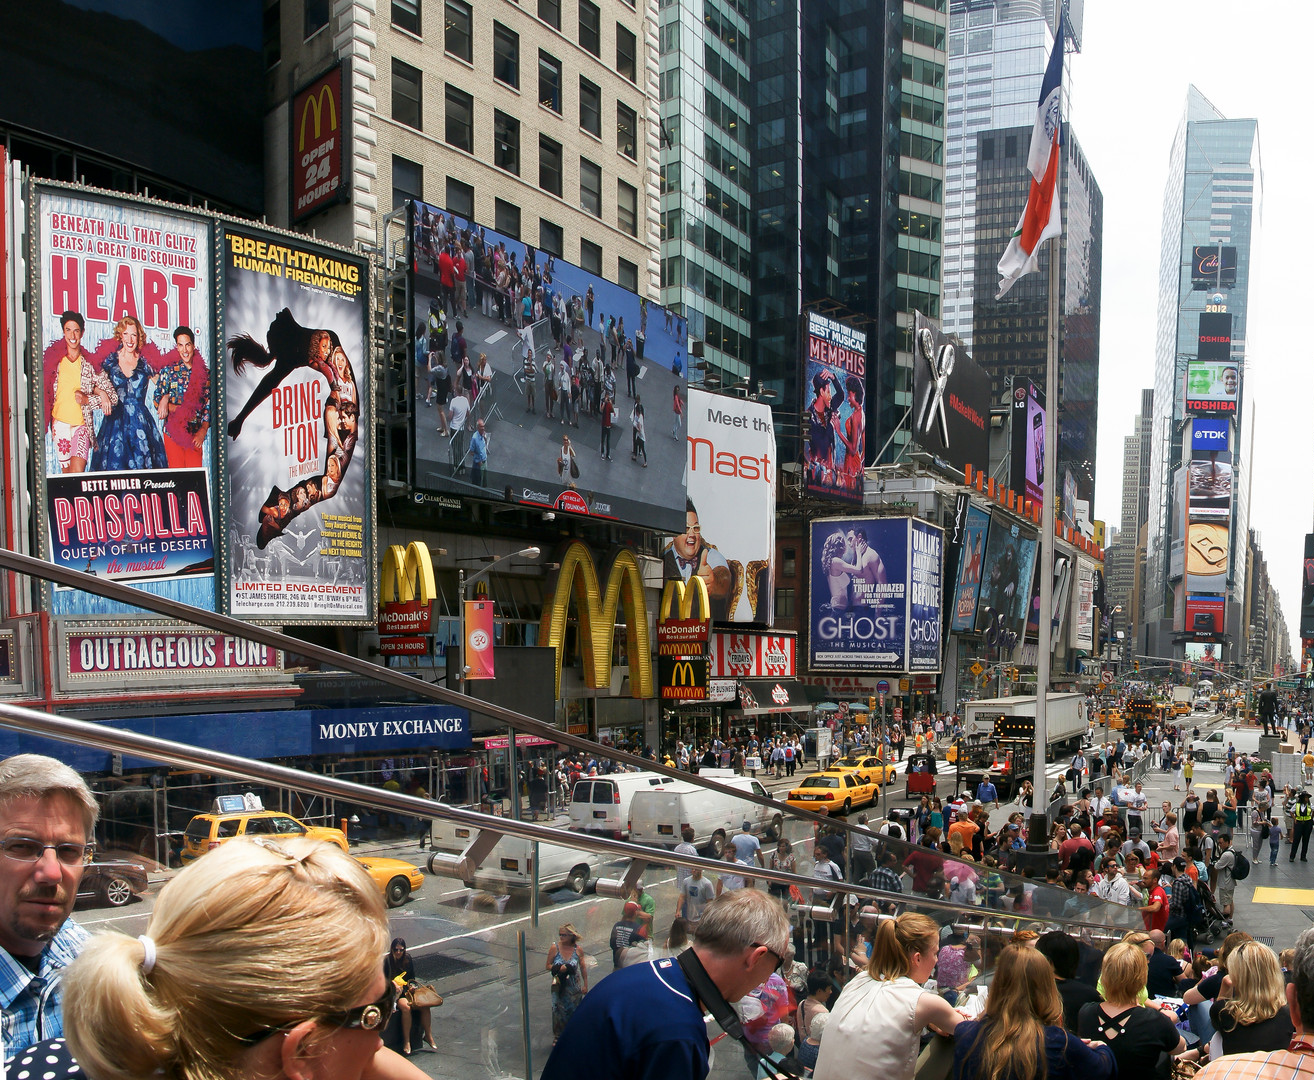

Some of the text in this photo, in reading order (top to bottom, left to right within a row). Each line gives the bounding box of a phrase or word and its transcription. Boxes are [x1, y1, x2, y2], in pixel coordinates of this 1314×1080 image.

[302, 138, 334, 167] OPEN
[305, 155, 330, 189] 24
[298, 176, 338, 209] HOURS
[109, 222, 129, 240] ALL
[134, 227, 161, 247] THAT
[165, 234, 196, 252] GLITZ
[52, 234, 196, 270] BEATS A GREAT BIG SEQUINED
[234, 255, 282, 276] HUMAN
[340, 294, 354, 302] TIMES
[1206, 304, 1227, 313] 2012
[810, 322, 830, 338] BEST
[832, 331, 865, 352] MUSICAL
[810, 337, 865, 376] MEMPHIS
[272, 380, 322, 429] BRING
[1187, 401, 1235, 410] TOSHIBA
[708, 409, 747, 428] Meet
[285, 421, 318, 463] IT ON
[1202, 431, 1226, 439] TDK
[289, 460, 319, 478] THE MUSICAL
[82, 479, 176, 492] BETTE MIDLER Presents
[54, 492, 208, 546] PRISCILLA
[61, 539, 207, 560] QUEEN OF THE DESERT
[107, 556, 168, 574] the musical
[913, 552, 939, 573] ANYTHING
[913, 570, 923, 582] SEEN
[236, 583, 362, 594] LIMITED ENGAGEMENT
[854, 584, 904, 592] TRULY AMAZED
[961, 587, 974, 599] MARY
[957, 598, 976, 612] POPPINS
[380, 611, 428, 622] McDonald's
[659, 625, 706, 634] McDonald's
[819, 617, 899, 640] GHOST
[910, 616, 940, 642] GHOST
[80, 638, 268, 670] OUTRAGEOUS FUN!
[801, 677, 862, 686] DIGITAL
[320, 718, 462, 739] MONEY EXCHANGE
